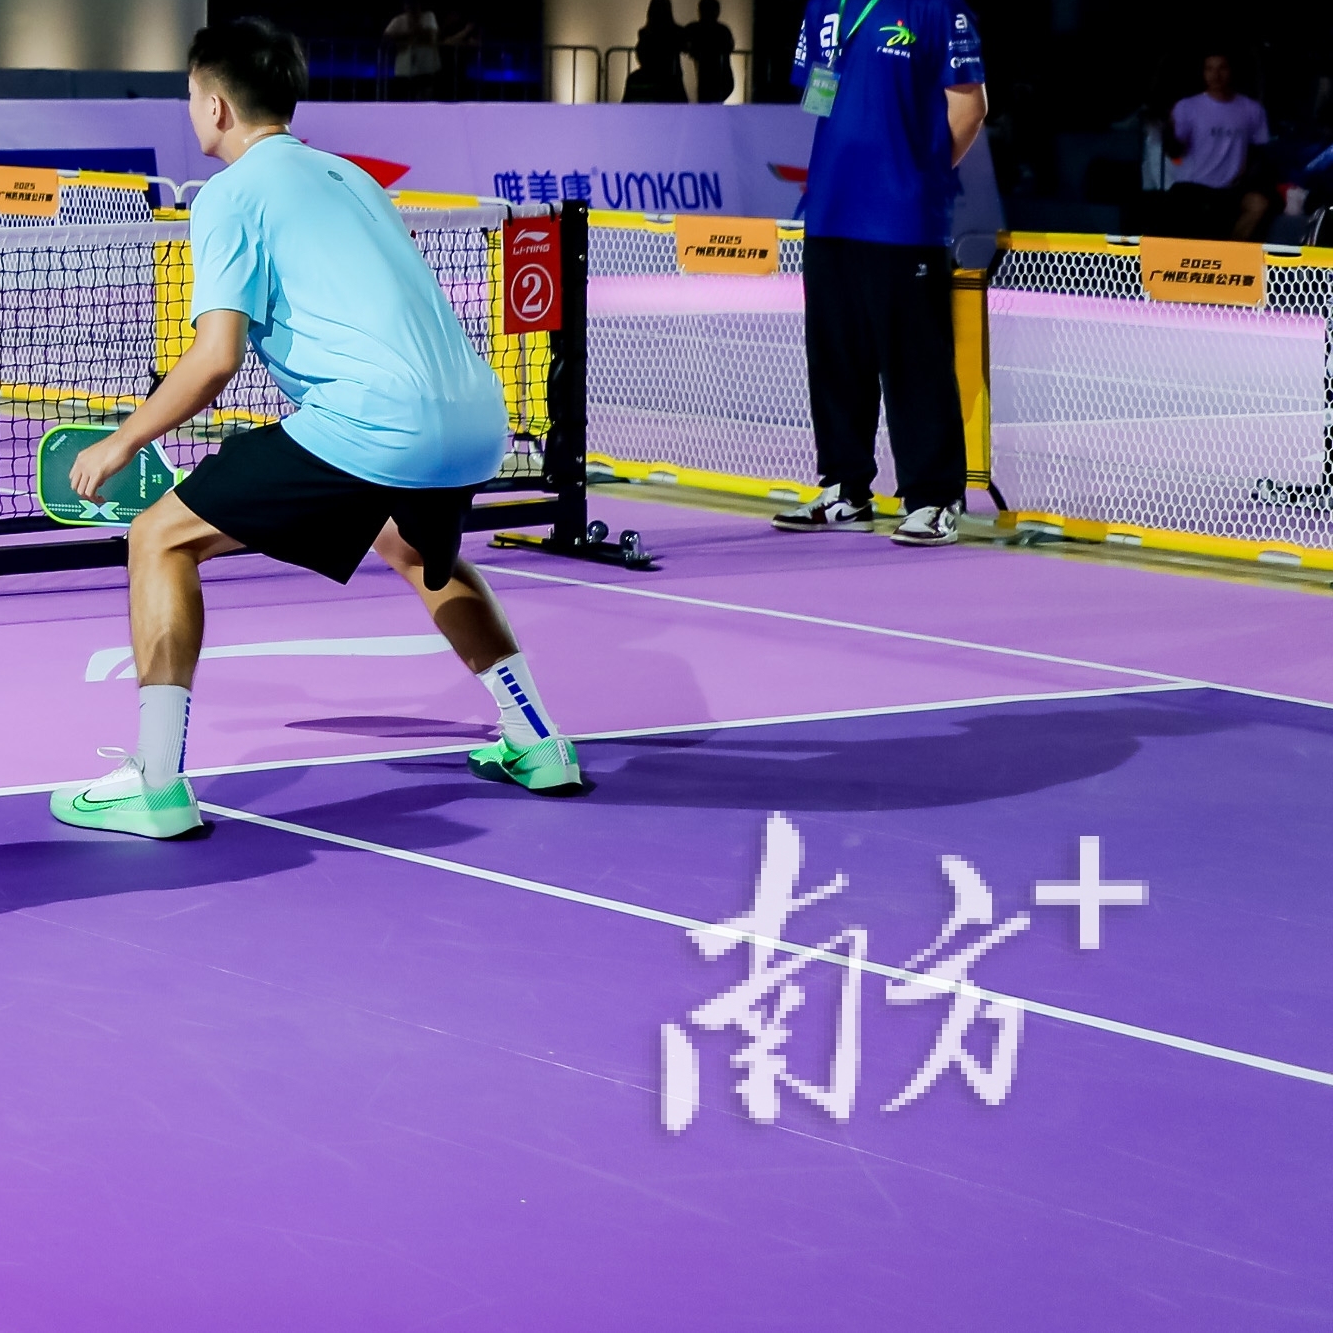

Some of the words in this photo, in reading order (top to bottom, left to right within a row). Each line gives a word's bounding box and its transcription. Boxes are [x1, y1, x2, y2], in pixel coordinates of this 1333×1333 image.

[494, 170, 591, 209] 唯美康
[709, 234, 742, 245] 2025
[512, 243, 551, 255] LI-NING
[684, 245, 769, 260] 广州匹克球公开赛
[1180, 258, 1222, 270] 2025
[1149, 270, 1255, 287] 广州匹克球公开赛
